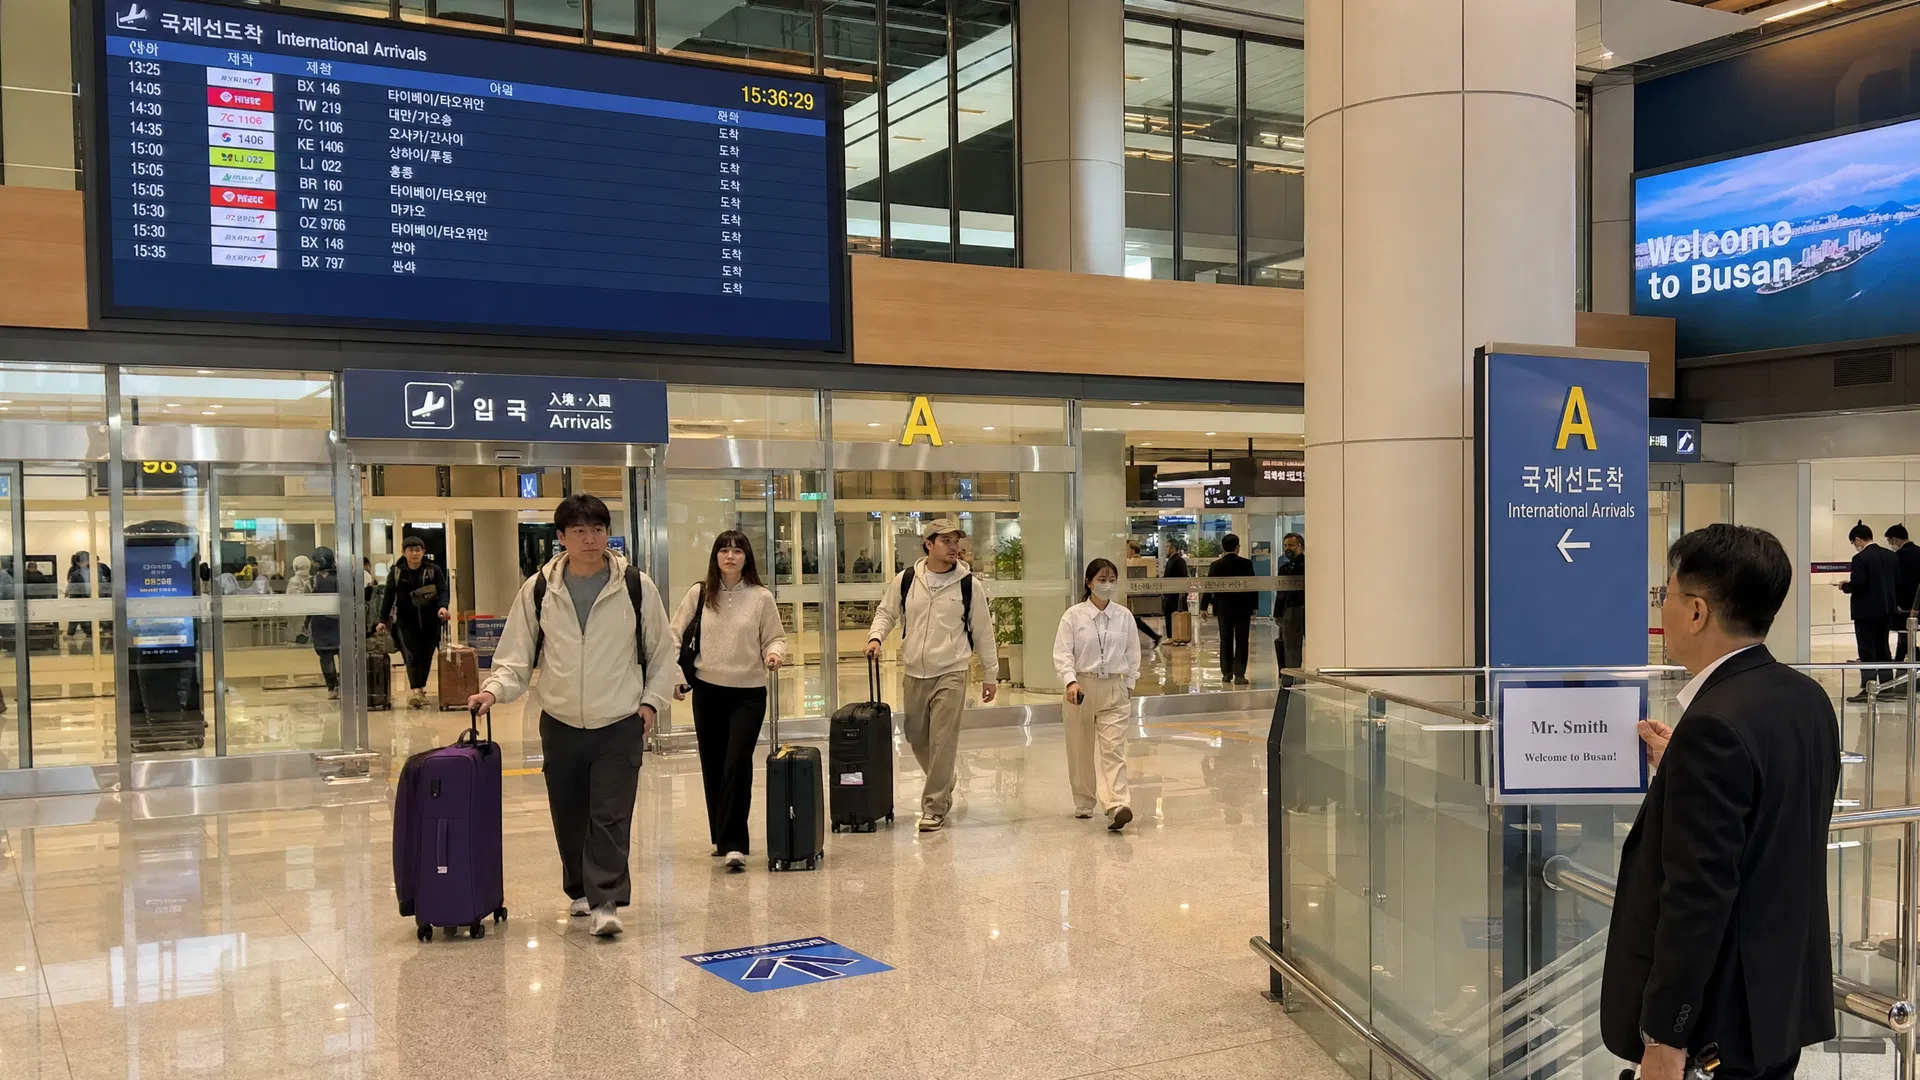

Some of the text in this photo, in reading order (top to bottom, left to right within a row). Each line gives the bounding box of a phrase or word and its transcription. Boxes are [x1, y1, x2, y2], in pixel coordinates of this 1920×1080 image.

[160, 13, 263, 45] 국제선도착
[276, 30, 427, 62] International Arrivals
[129, 60, 160, 76] 13:25
[129, 80, 161, 96] 14:05
[297, 80, 340, 95] BX 146
[388, 89, 485, 112] 타이베이/타오위안
[741, 85, 814, 111] 15:36:29
[130, 101, 162, 116] 14:30
[297, 99, 341, 114] TW 219
[220, 113, 262, 125] 7C 1106
[297, 118, 343, 134] 7C 1106
[130, 121, 162, 136] 14:35
[719, 128, 739, 141] 도착
[238, 134, 263, 145] 1406
[389, 128, 464, 146] 오사카/간사이
[131, 142, 163, 156] 15:00
[297, 138, 344, 153] KE 1406
[719, 145, 739, 158] 도착
[234, 154, 244, 162] LJ
[300, 158, 342, 173] LJ 022
[131, 162, 164, 176] 15:05
[720, 162, 740, 175] 도착
[132, 182, 164, 197] 15:05
[299, 177, 342, 191] BR 160
[720, 179, 740, 192] 도착
[390, 184, 488, 204] 타이베이/타오위안
[299, 197, 343, 212] TW 251
[721, 196, 741, 209] 도착
[132, 203, 165, 218] 15:30
[390, 204, 426, 217] 마카오
[300, 216, 346, 231] OZ 9766
[721, 214, 741, 226] 도착
[133, 224, 165, 238] 15:30
[391, 223, 488, 242] 타이베이/타오위안
[722, 231, 742, 243] 도착
[301, 236, 344, 250] BX 148
[391, 241, 416, 255] 싼야
[1647, 219, 1792, 266] Welcome
[134, 244, 166, 258] 15:35
[722, 248, 742, 261] 도착
[302, 256, 344, 269] BX 797
[722, 265, 742, 278] 도착
[1648, 256, 1792, 300] to Busan
[722, 282, 742, 295] 도착
[550, 414, 612, 430] Arrivals
[899, 396, 943, 447] A
[1554, 386, 1598, 452] A
[1521, 466, 1624, 494] 국제선도착
[1508, 502, 1635, 519] International Arrivals
[1531, 720, 1608, 734] Mr. Smith
[1525, 752, 1617, 762] Welcome to Busan!
